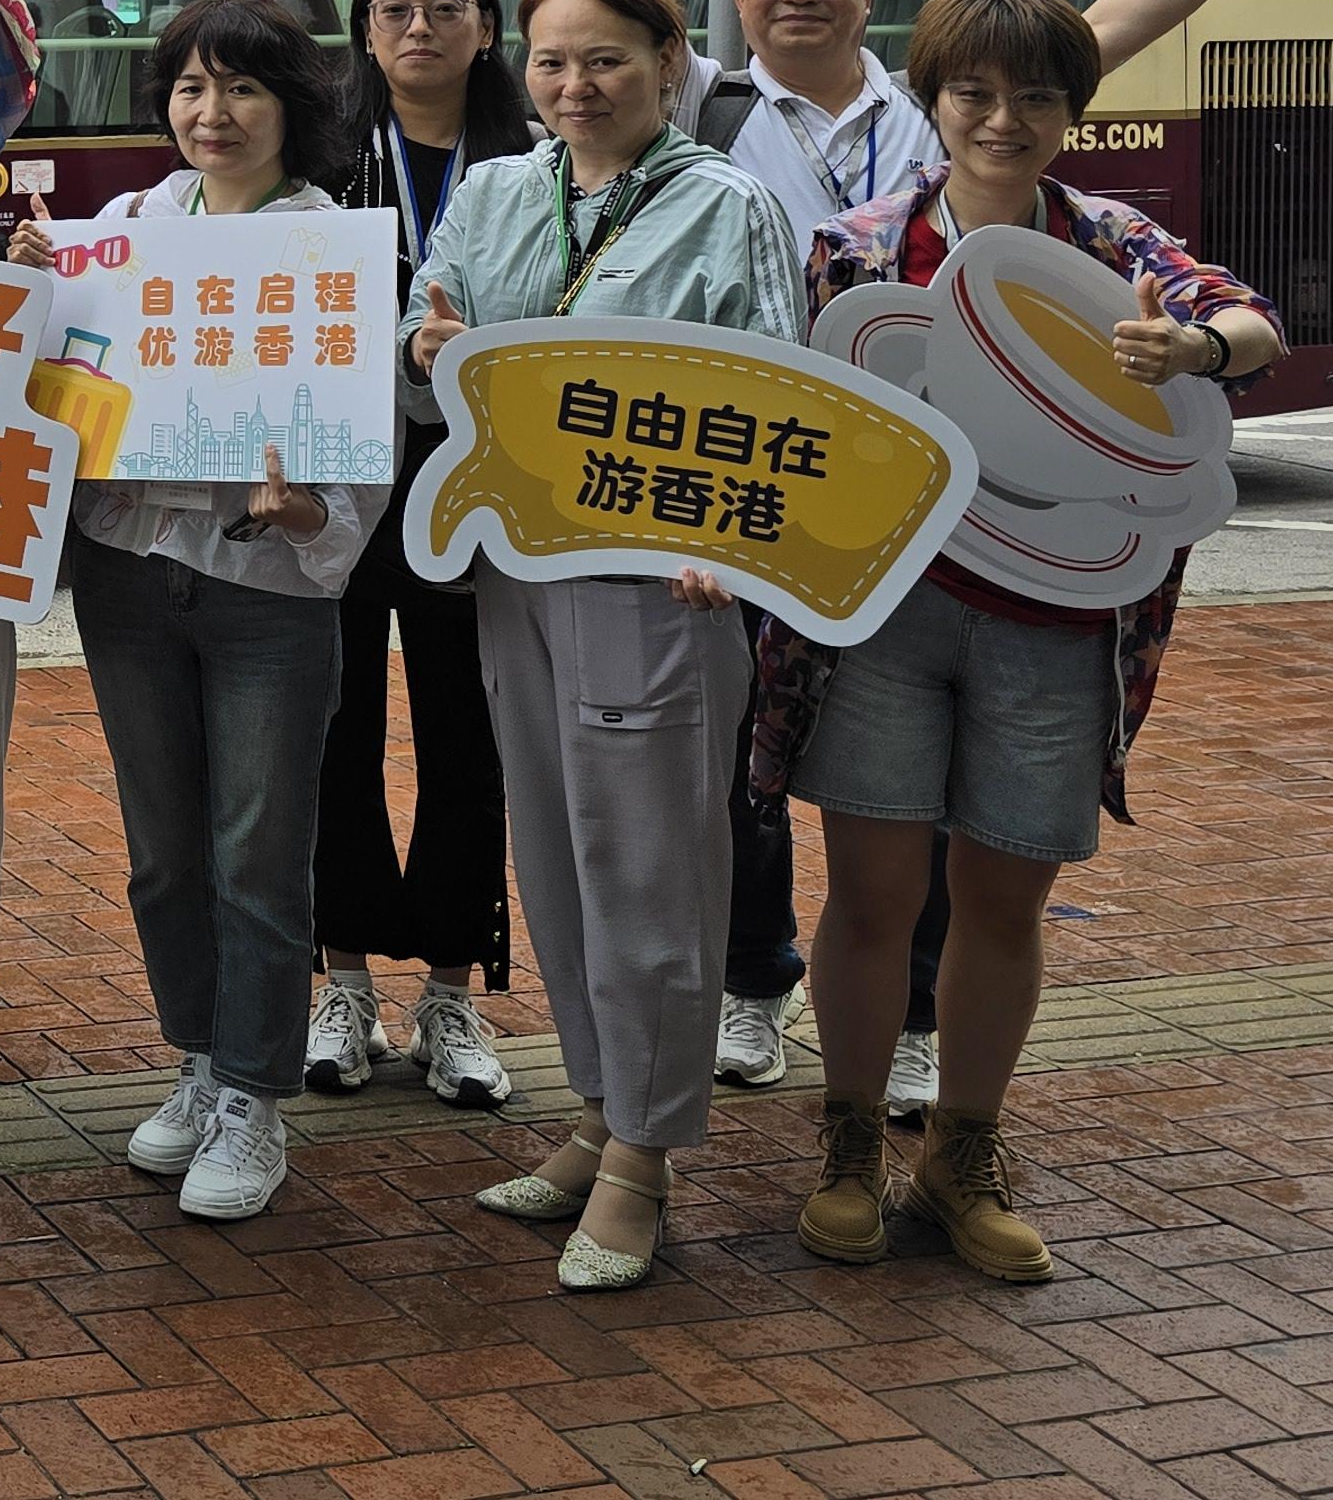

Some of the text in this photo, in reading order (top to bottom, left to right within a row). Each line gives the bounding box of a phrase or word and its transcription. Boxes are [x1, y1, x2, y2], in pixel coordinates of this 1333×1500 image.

[1063, 122, 1164, 152] RS.COM
[141, 271, 356, 317] 自在启程
[137, 323, 357, 367] 优游香港
[557, 378, 831, 479] 自由自在
[576, 449, 785, 543] 游香港
